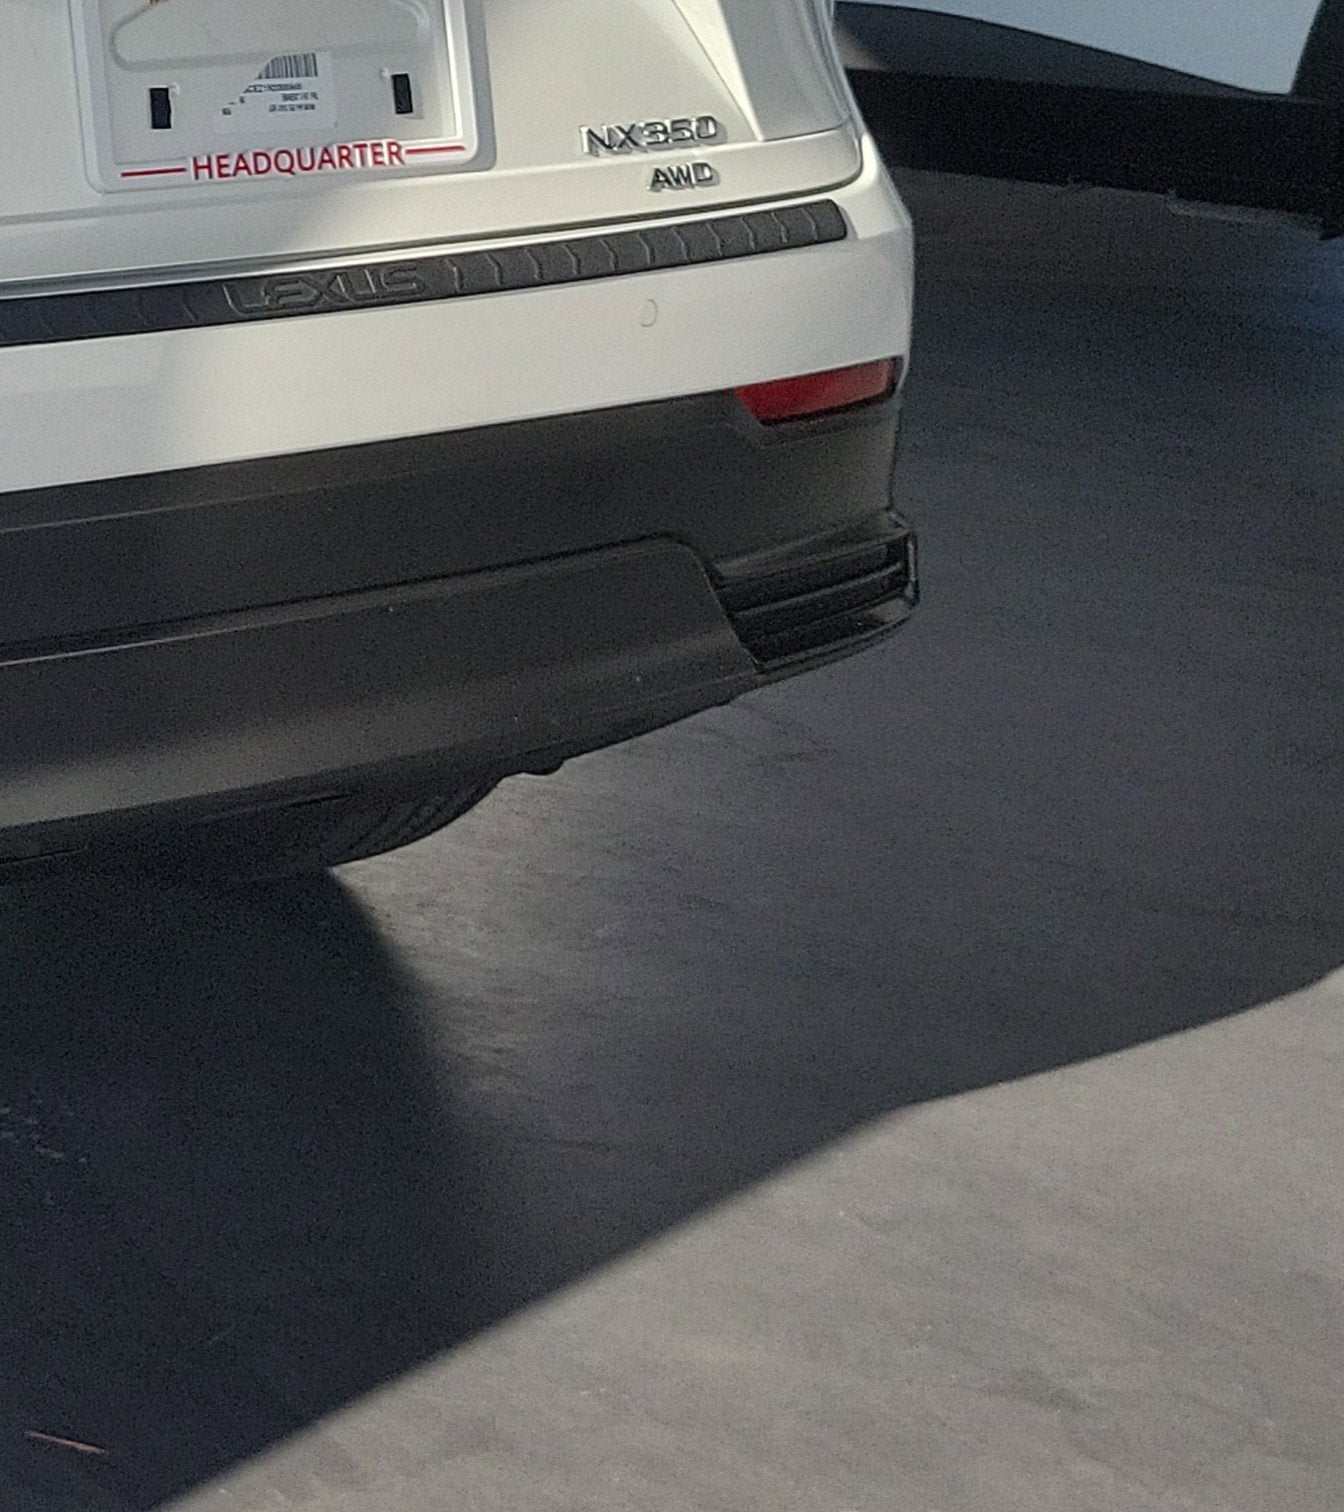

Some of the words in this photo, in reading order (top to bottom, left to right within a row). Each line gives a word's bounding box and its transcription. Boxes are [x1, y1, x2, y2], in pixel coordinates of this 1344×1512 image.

[191, 140, 406, 181] HEADQUARTER
[648, 161, 715, 191] AWD
[221, 262, 426, 319] LEXUS
